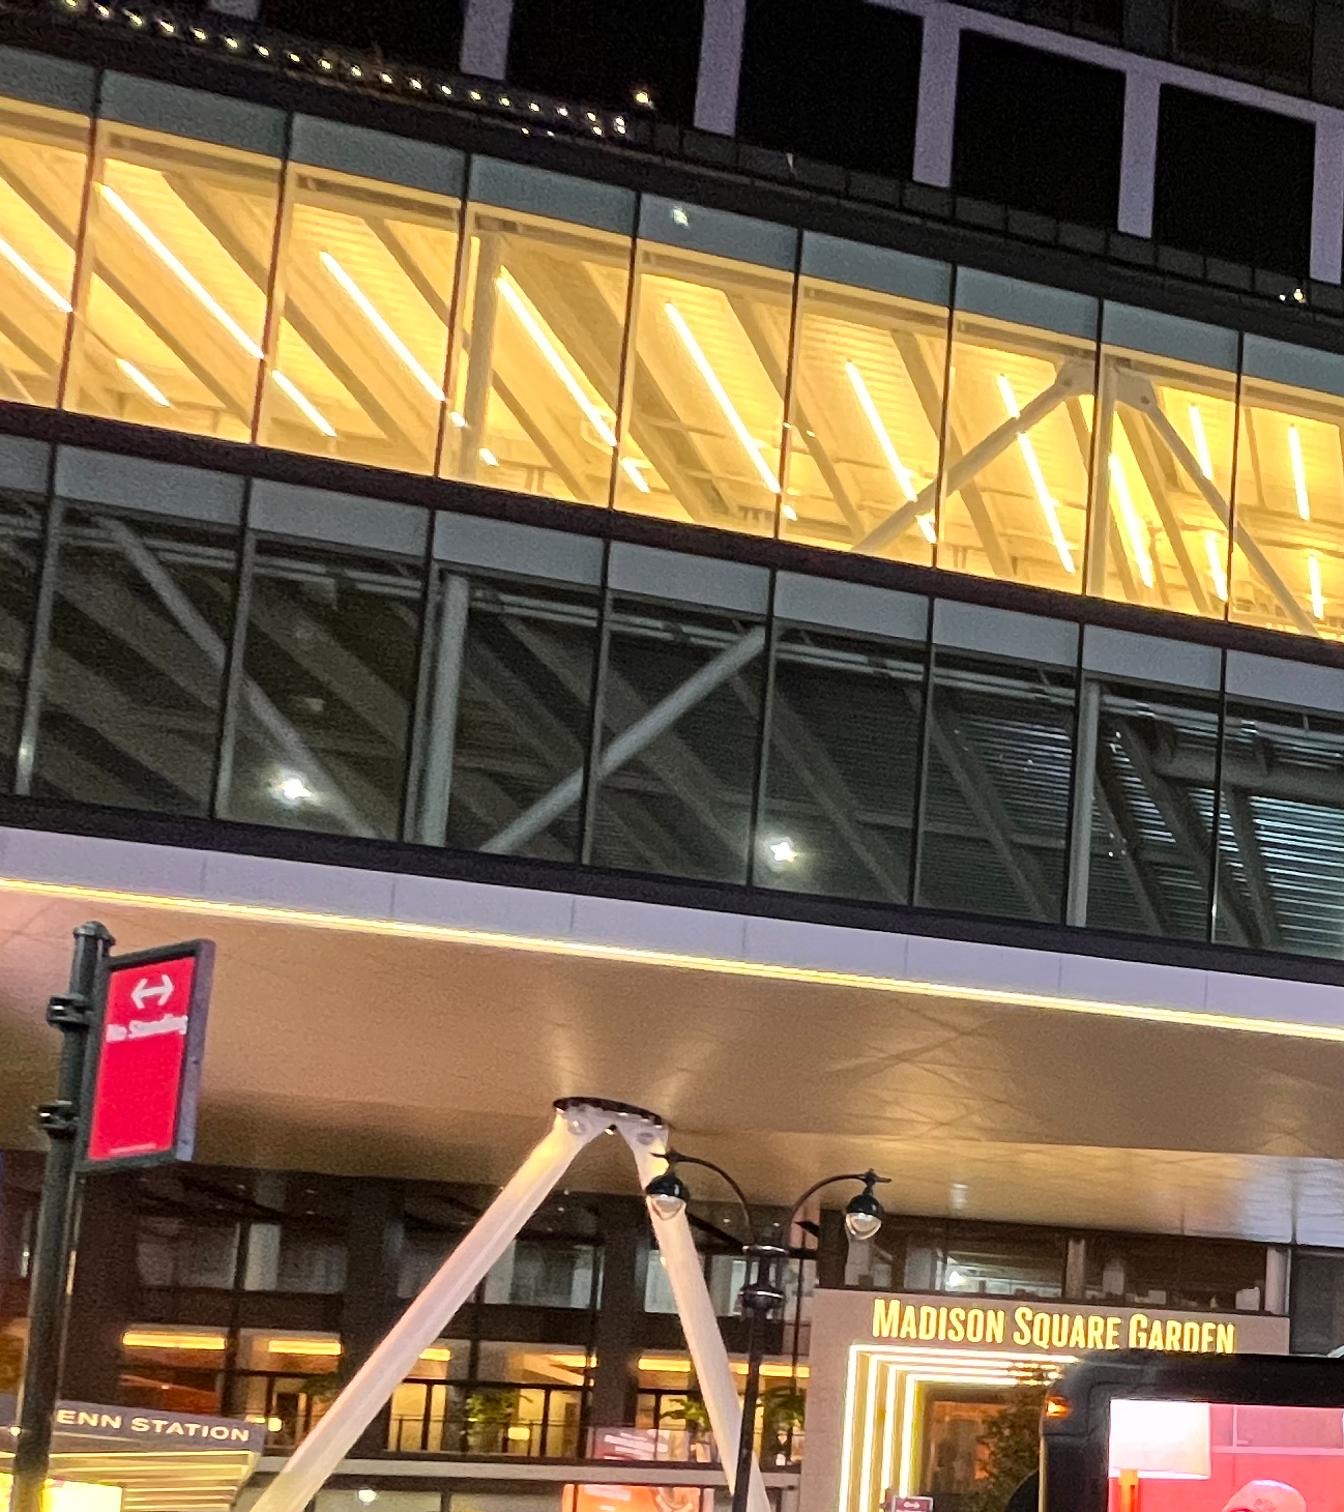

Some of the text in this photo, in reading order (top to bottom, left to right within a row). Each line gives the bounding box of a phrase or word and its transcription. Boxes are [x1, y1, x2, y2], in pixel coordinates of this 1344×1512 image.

[872, 1298, 1235, 1353] MADISON SQUARE GARDEN
[56, 1409, 249, 1442] ENN STATION
